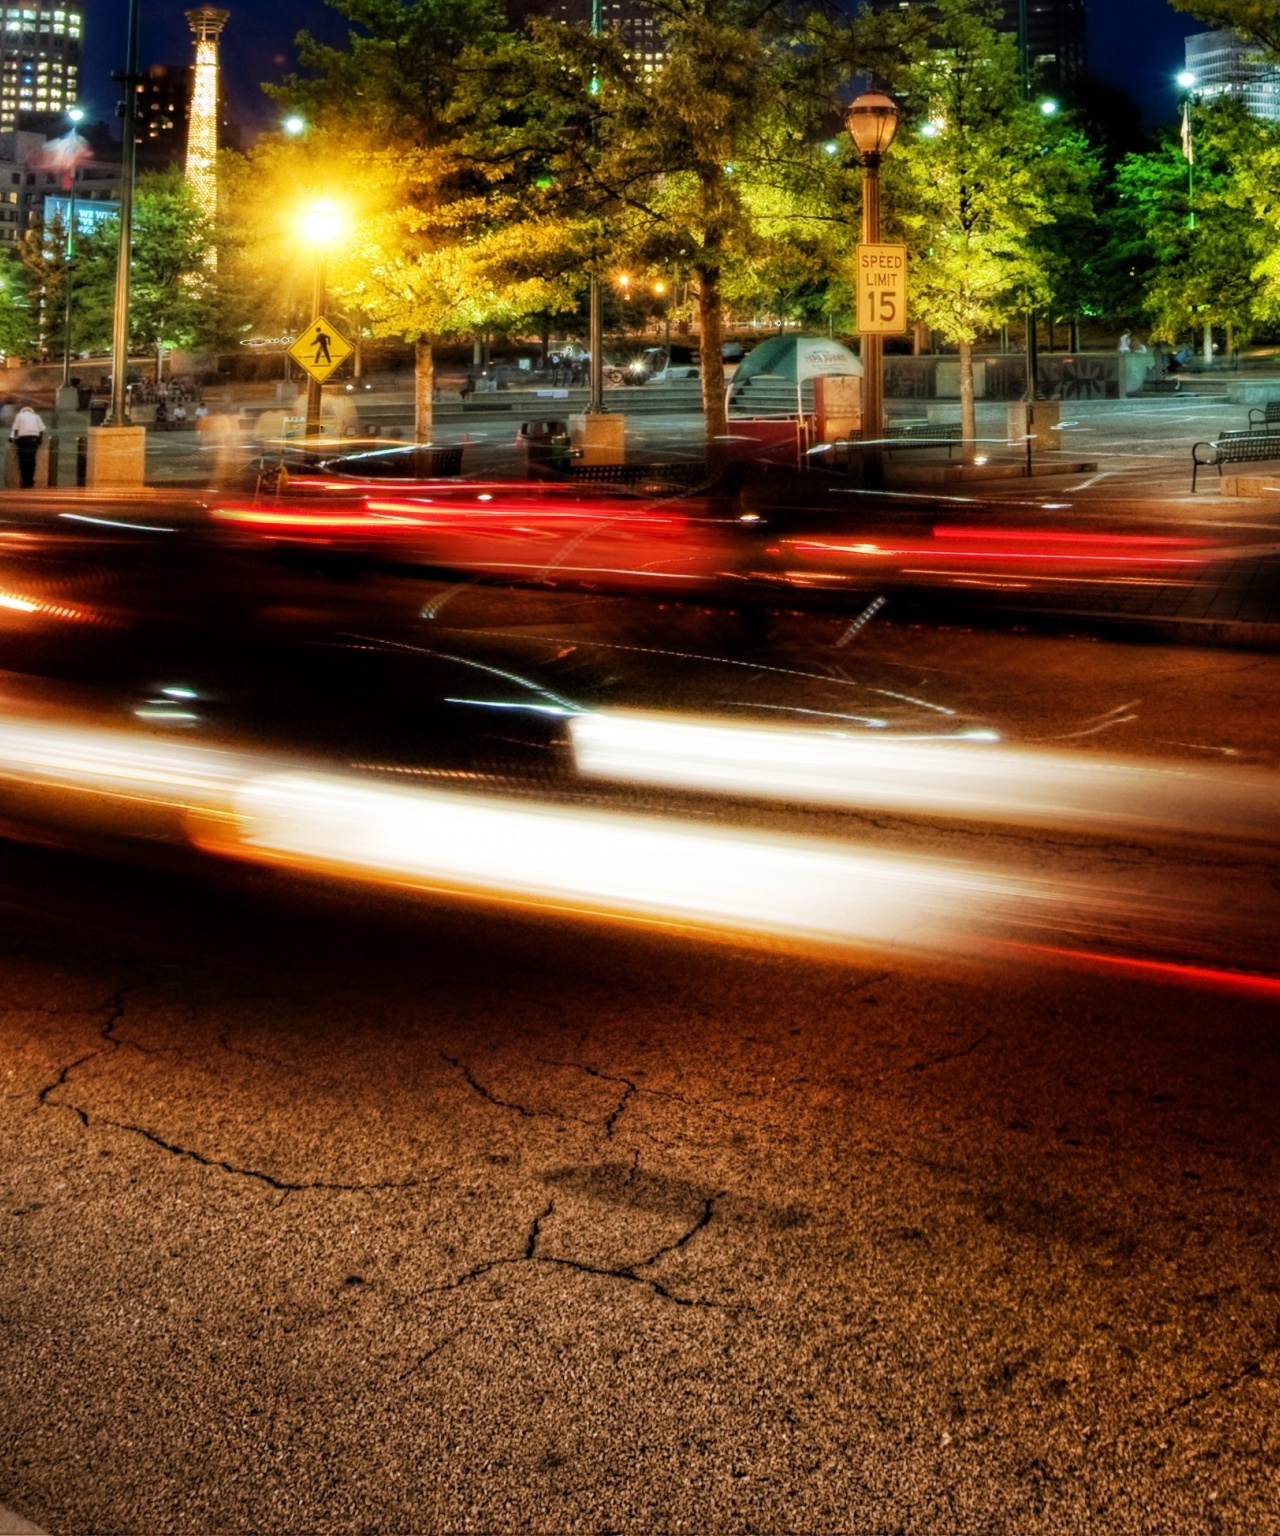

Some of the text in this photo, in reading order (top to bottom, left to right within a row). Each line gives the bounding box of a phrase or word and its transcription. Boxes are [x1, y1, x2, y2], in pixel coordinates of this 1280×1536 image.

[862, 254, 902, 269] SPEED
[866, 273, 898, 287] LIMIT
[867, 291, 897, 323] 15
